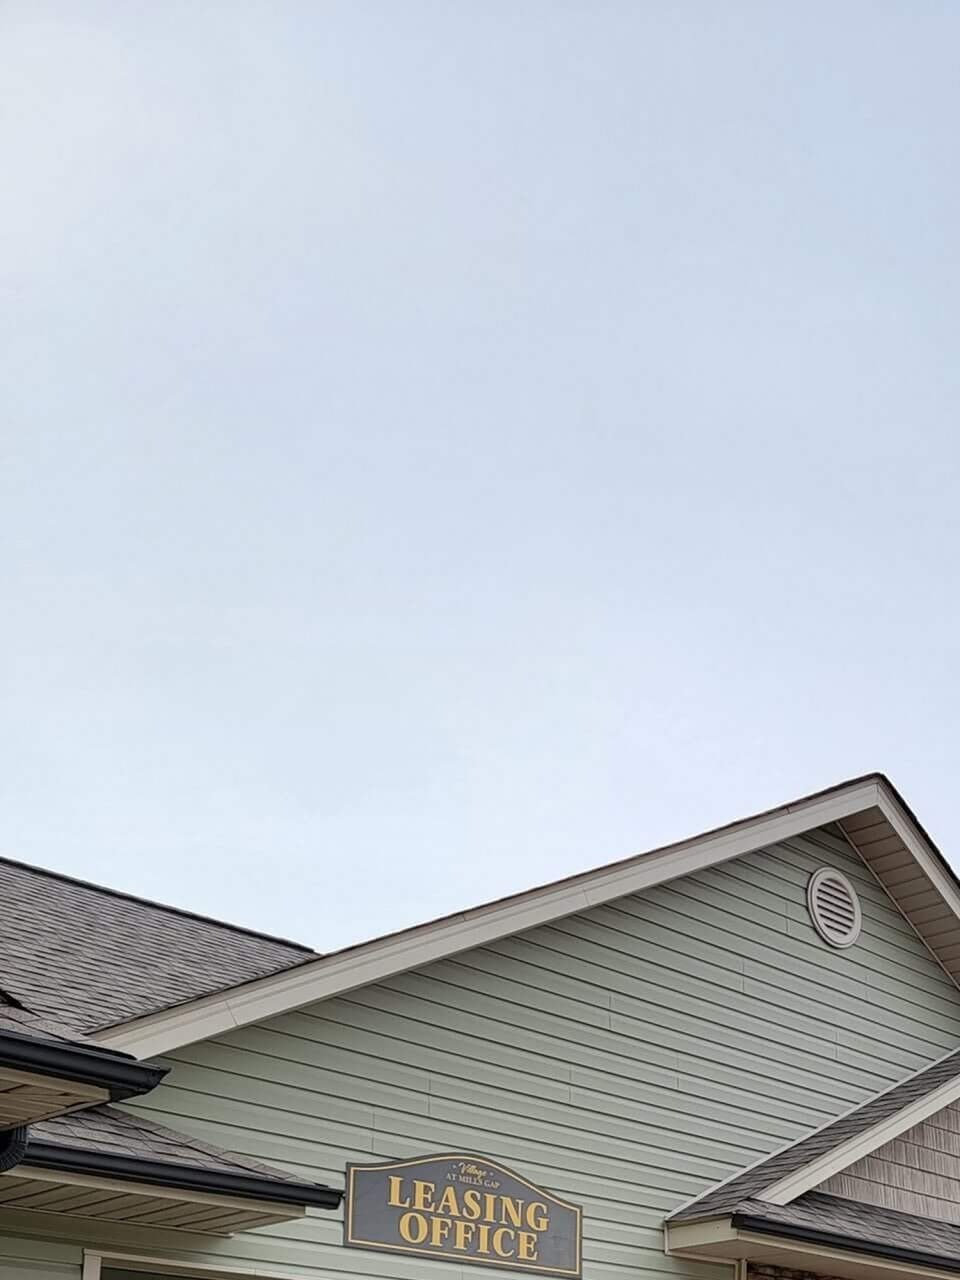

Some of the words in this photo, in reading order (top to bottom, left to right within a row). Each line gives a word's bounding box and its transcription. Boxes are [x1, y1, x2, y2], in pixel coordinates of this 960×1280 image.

[447, 1172, 457, 1181] AT
[459, 1175, 482, 1186] MILLS
[483, 1180, 500, 1189] GAP
[458, 1162, 487, 1180] Village
[387, 1175, 550, 1232] LEASING
[399, 1212, 539, 1261] OFFICE
